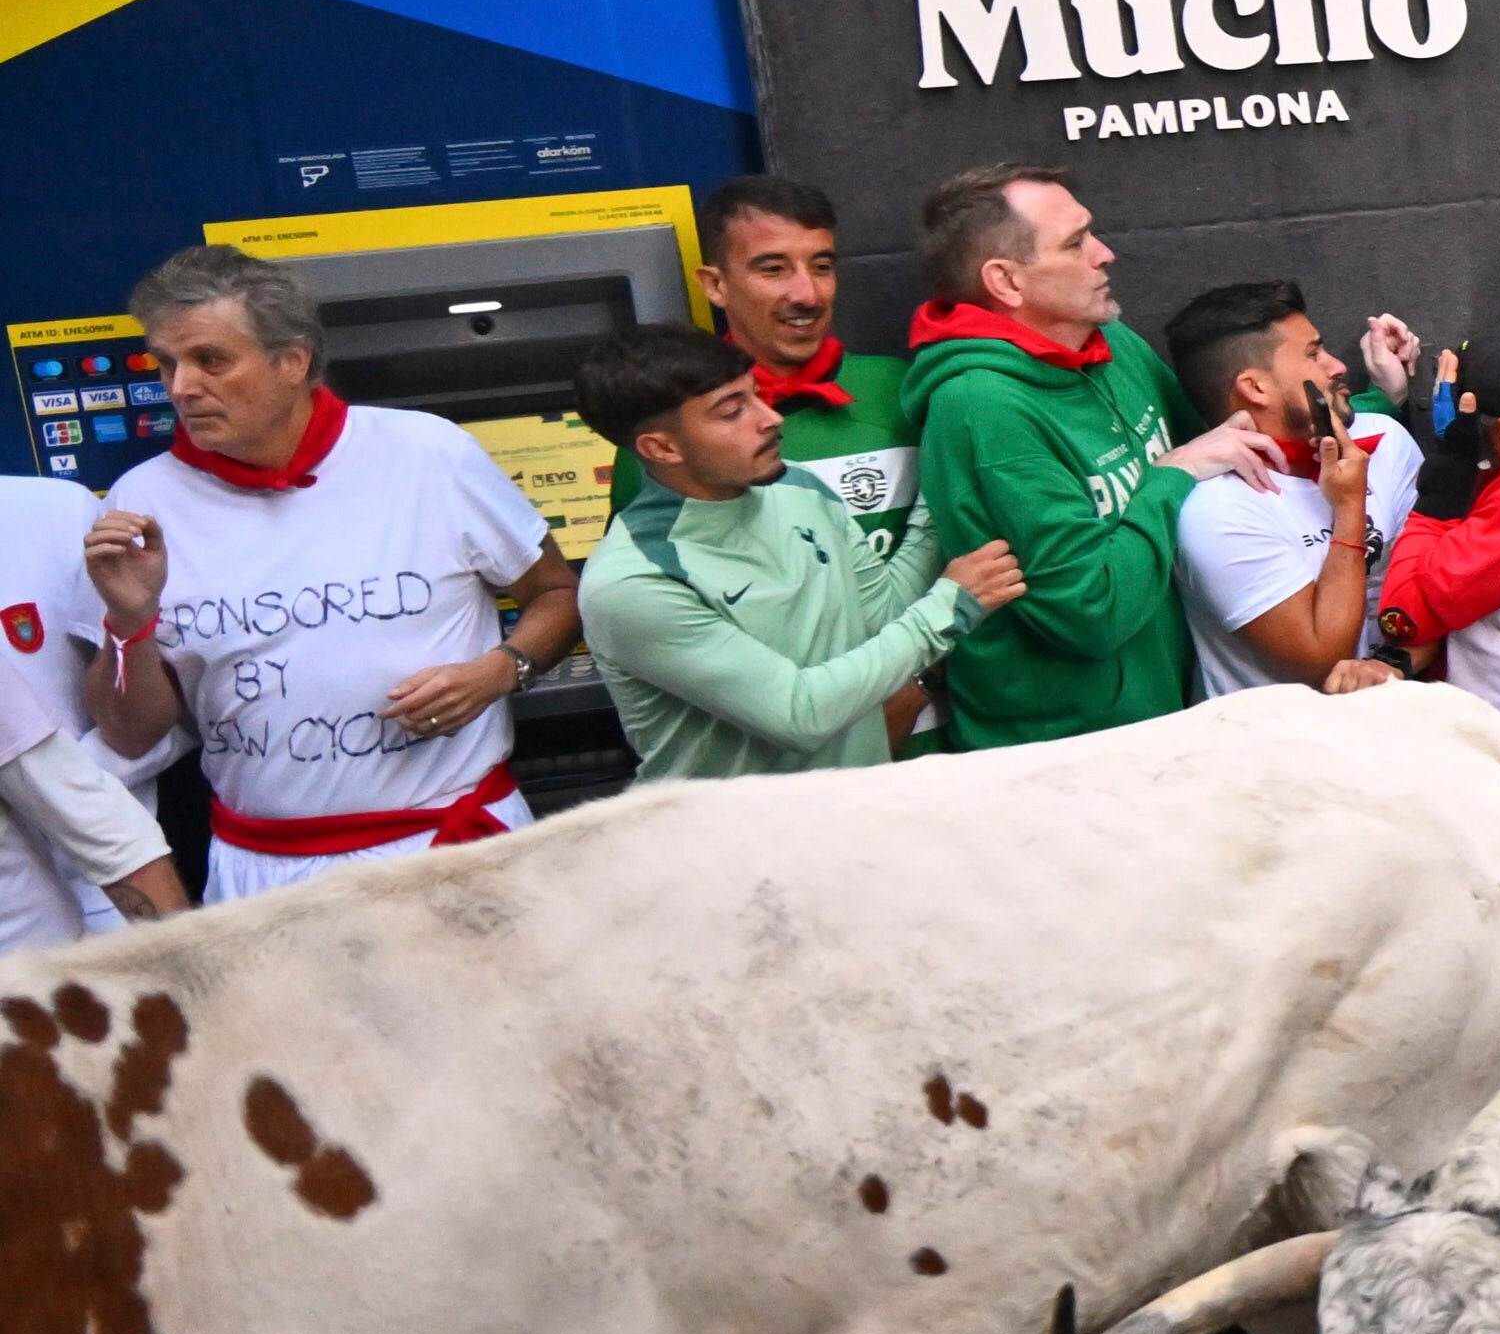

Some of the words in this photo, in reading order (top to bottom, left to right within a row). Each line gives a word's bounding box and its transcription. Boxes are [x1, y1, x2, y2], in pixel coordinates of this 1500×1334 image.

[1064, 90, 1350, 142] PAMPLONA
[20, 331, 43, 340] ATM
[42, 397, 72, 409] VISA
[89, 392, 118, 403] VISA
[546, 470, 577, 484] EVO
[234, 659, 289, 702] BY
